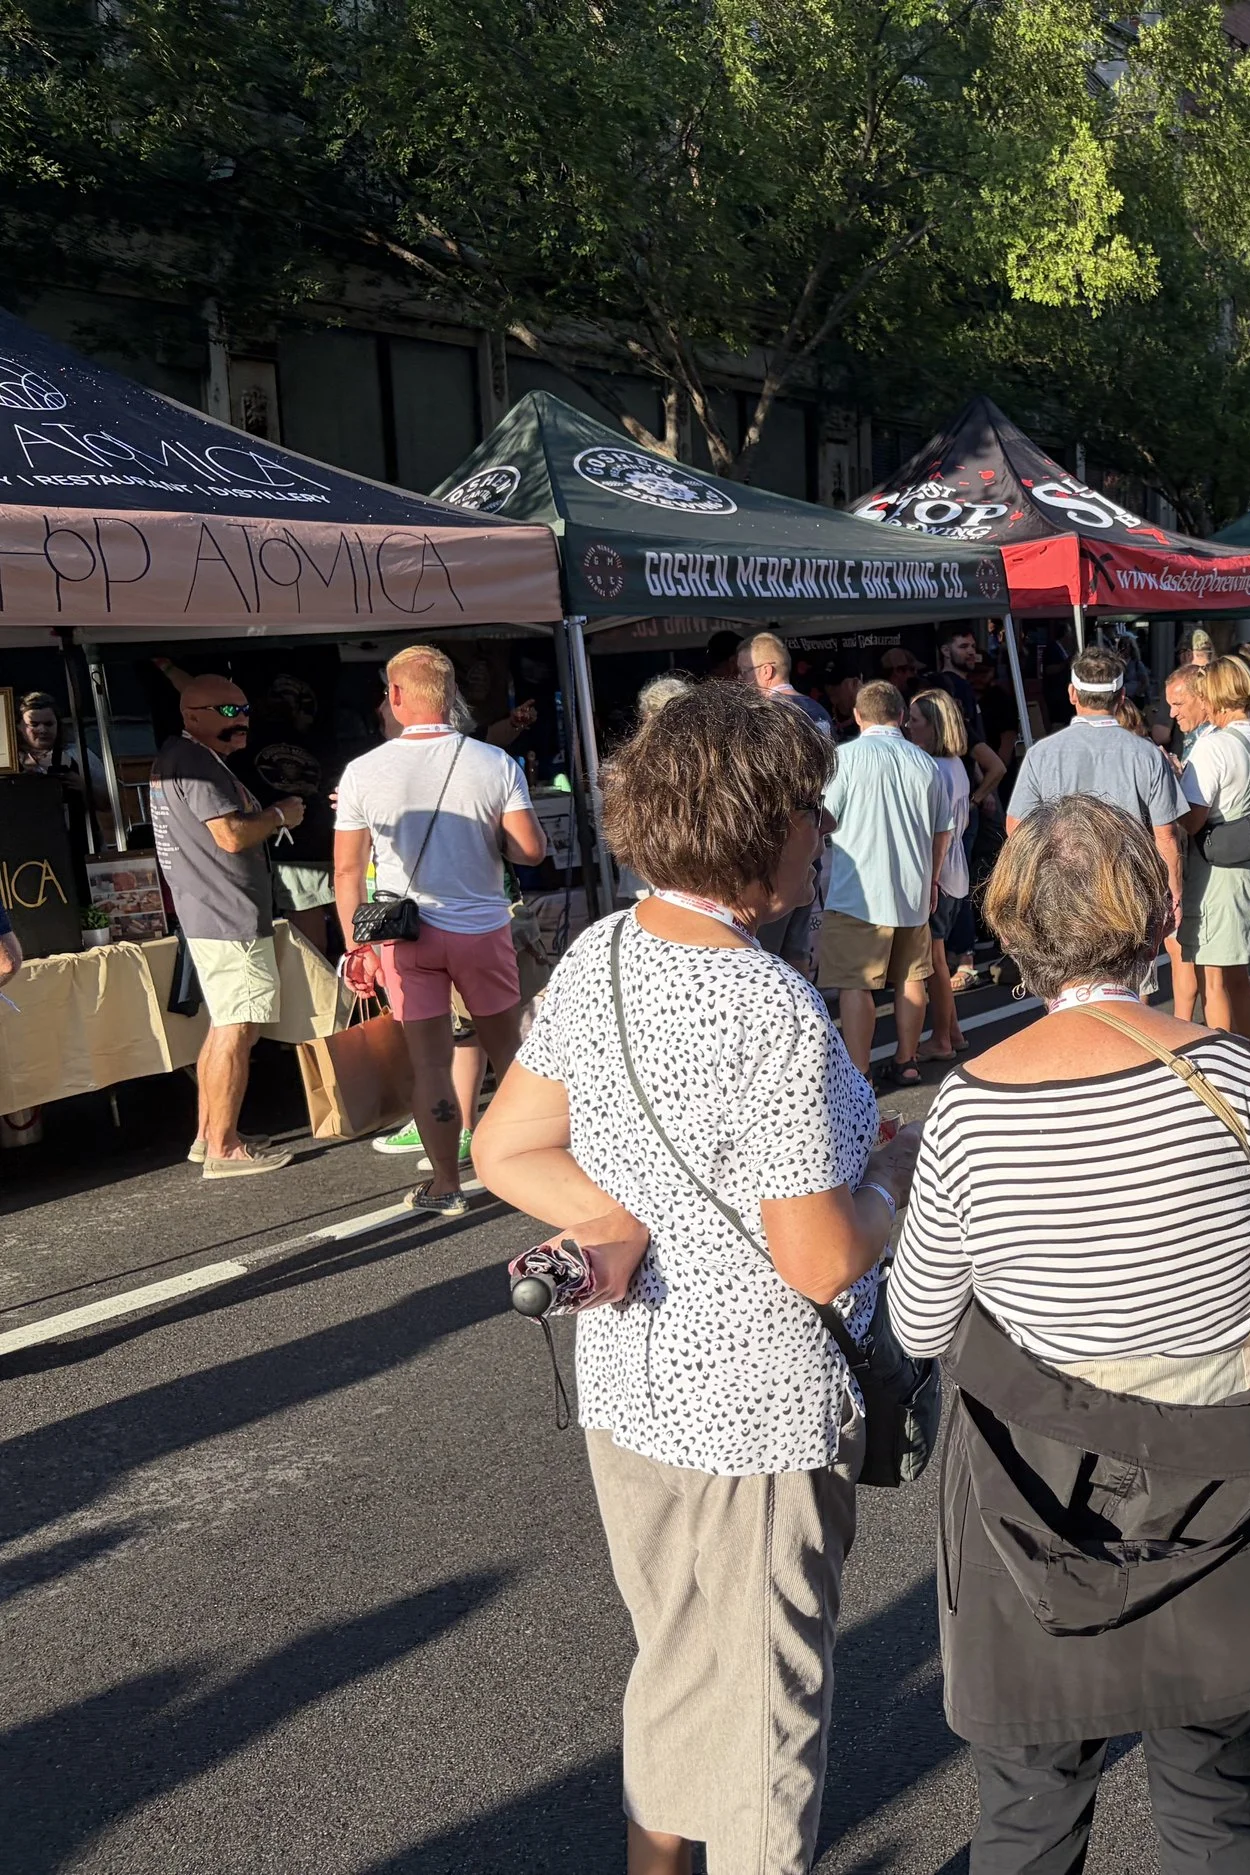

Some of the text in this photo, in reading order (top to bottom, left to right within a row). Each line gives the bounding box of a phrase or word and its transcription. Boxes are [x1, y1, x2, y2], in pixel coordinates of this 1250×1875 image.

[586, 452, 674, 475] GOSHEN
[32, 474, 195, 494] RESTAURANT
[208, 486, 331, 504] DISTILLERY
[449, 473, 512, 503] OSHEN
[184, 522, 465, 614] ATOMICA
[645, 551, 734, 597] GOSHEN
[736, 556, 861, 599] MERCANTILE
[860, 561, 938, 599] BREWING
[940, 562, 969, 599] CO.
